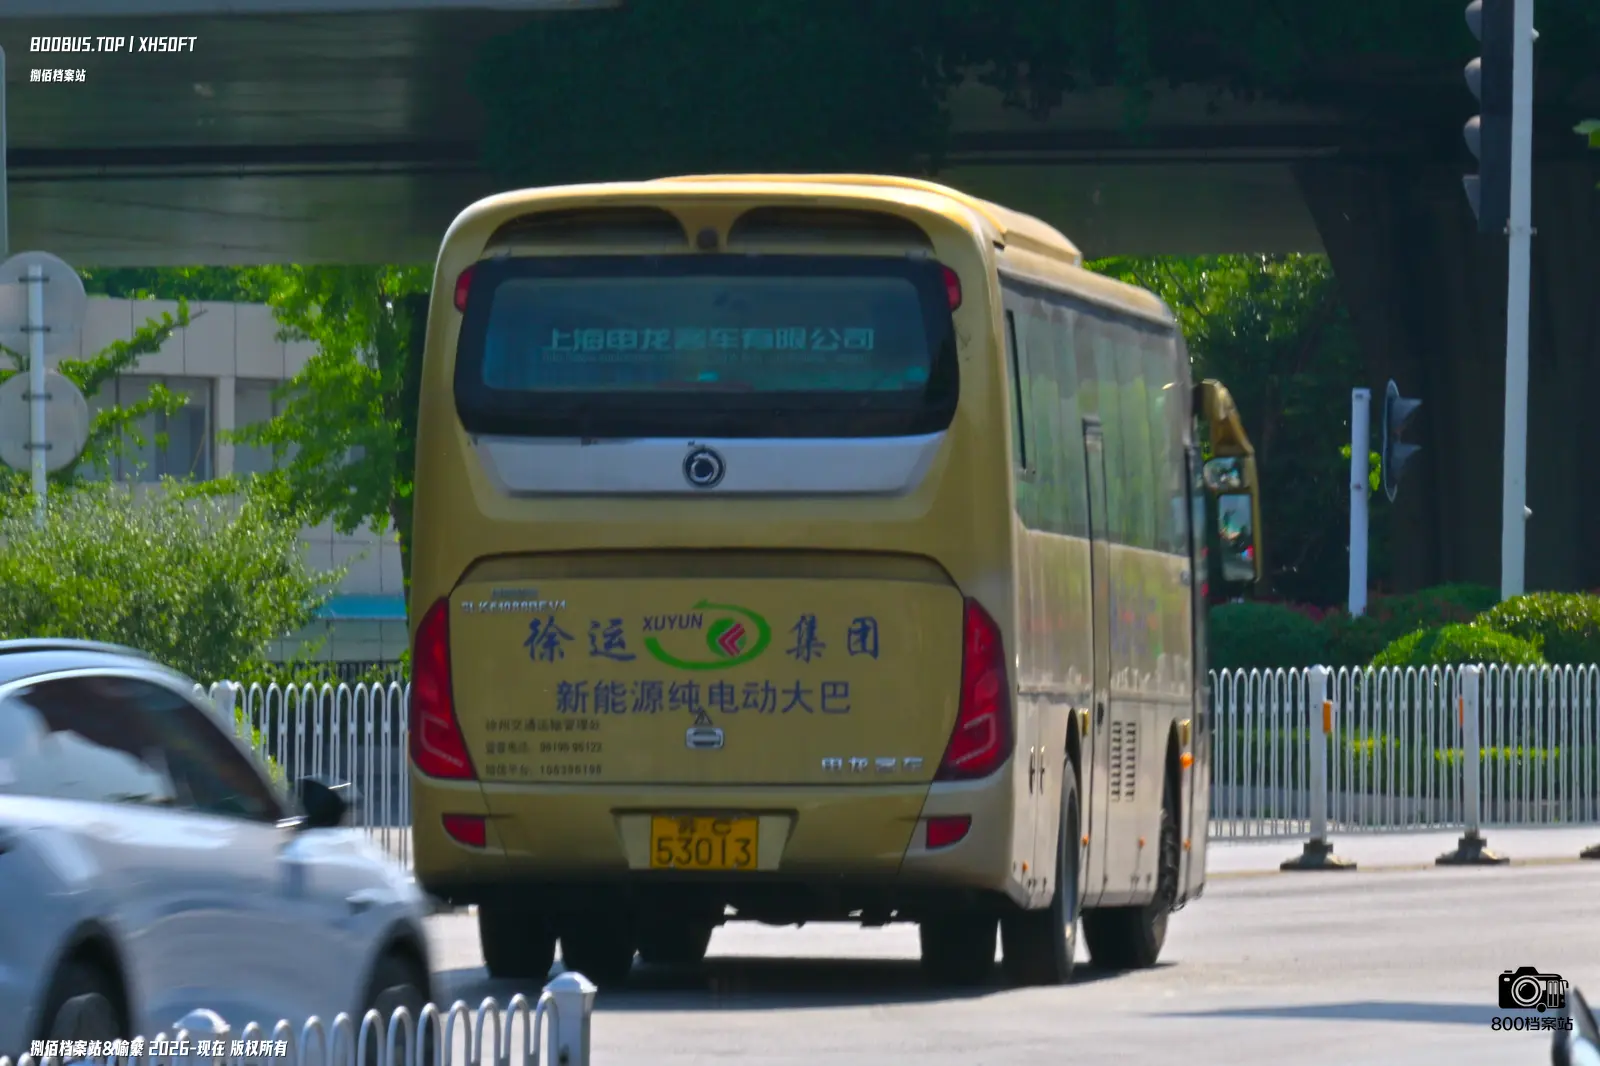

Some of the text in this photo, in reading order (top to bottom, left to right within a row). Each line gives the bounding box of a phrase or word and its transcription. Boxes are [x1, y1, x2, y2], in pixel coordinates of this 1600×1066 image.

[542, 327, 875, 351] 上海申龙客车有限公司
[643, 612, 703, 632] XUYUN
[523, 613, 880, 664] 徐运 集团
[556, 679, 851, 714] 新能源纯电动大巴
[656, 837, 753, 866] 53013
